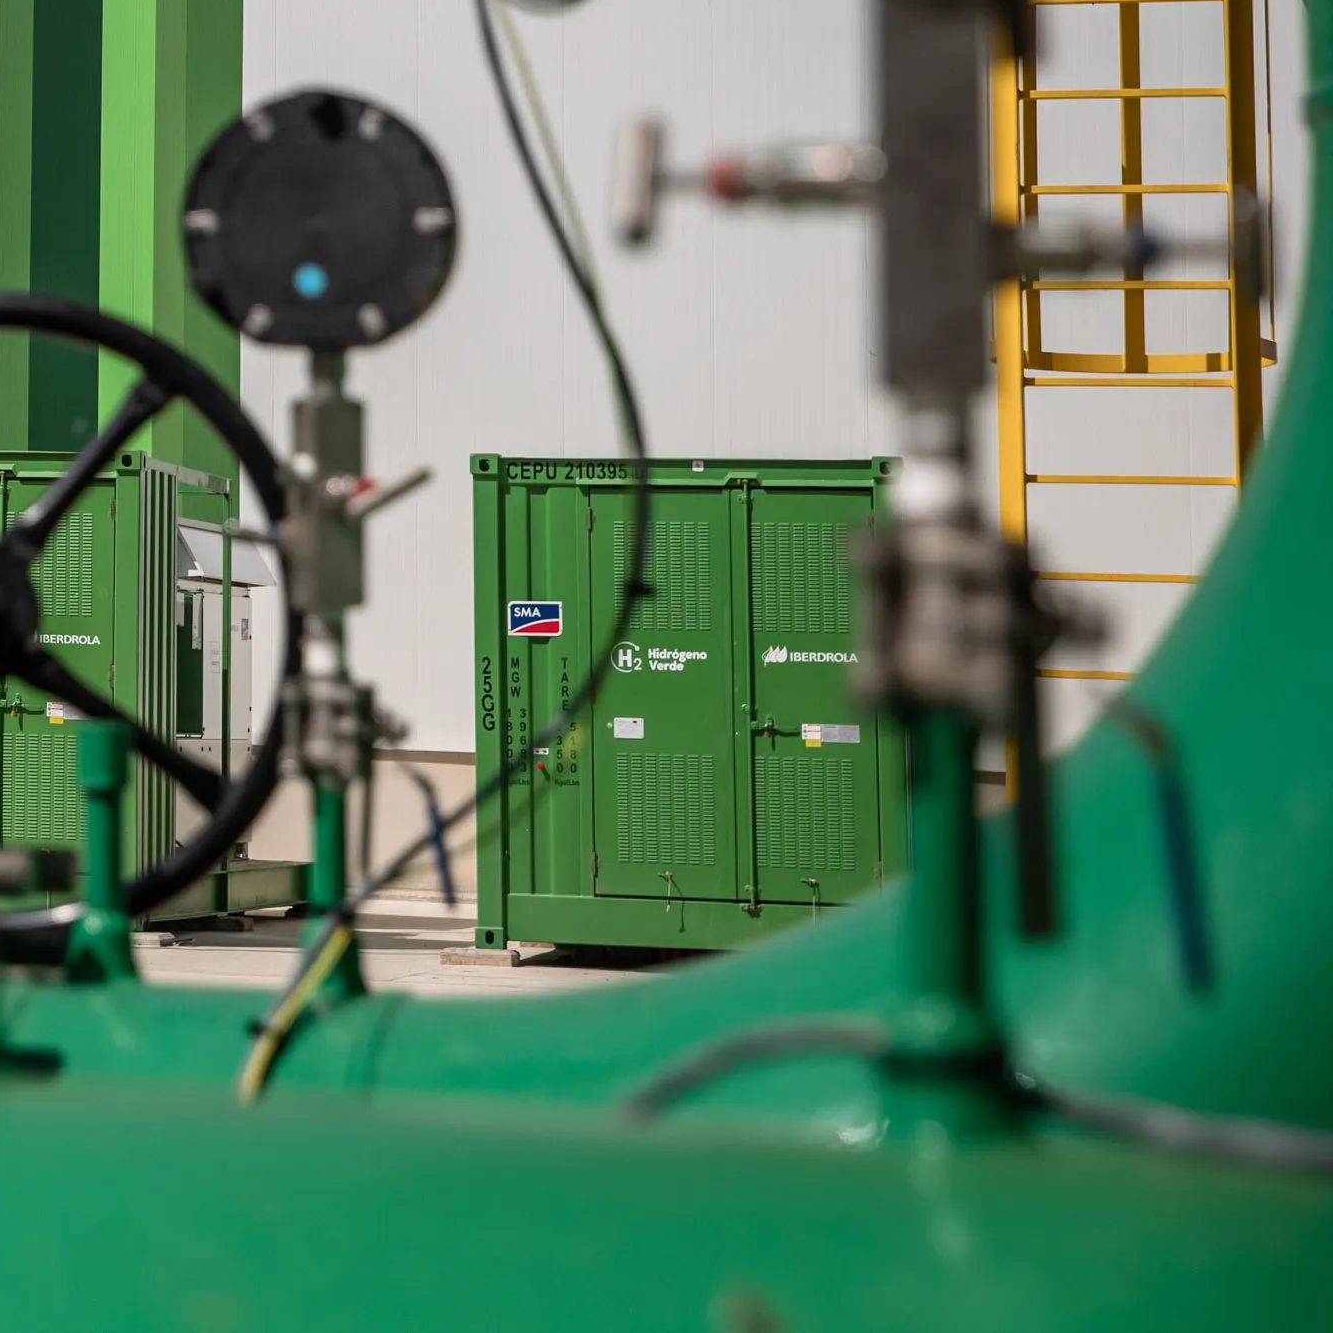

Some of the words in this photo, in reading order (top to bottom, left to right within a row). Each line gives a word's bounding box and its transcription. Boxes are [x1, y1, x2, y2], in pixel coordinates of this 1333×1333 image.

[506, 462, 557, 480] CEPU
[564, 462, 628, 480] 210395
[514, 607, 541, 617] SMA
[40, 634, 101, 645] IBERDROLA
[648, 648, 708, 661] Hidrógeno
[789, 652, 859, 664] IBERDROLA
[649, 660, 685, 672] Verde
